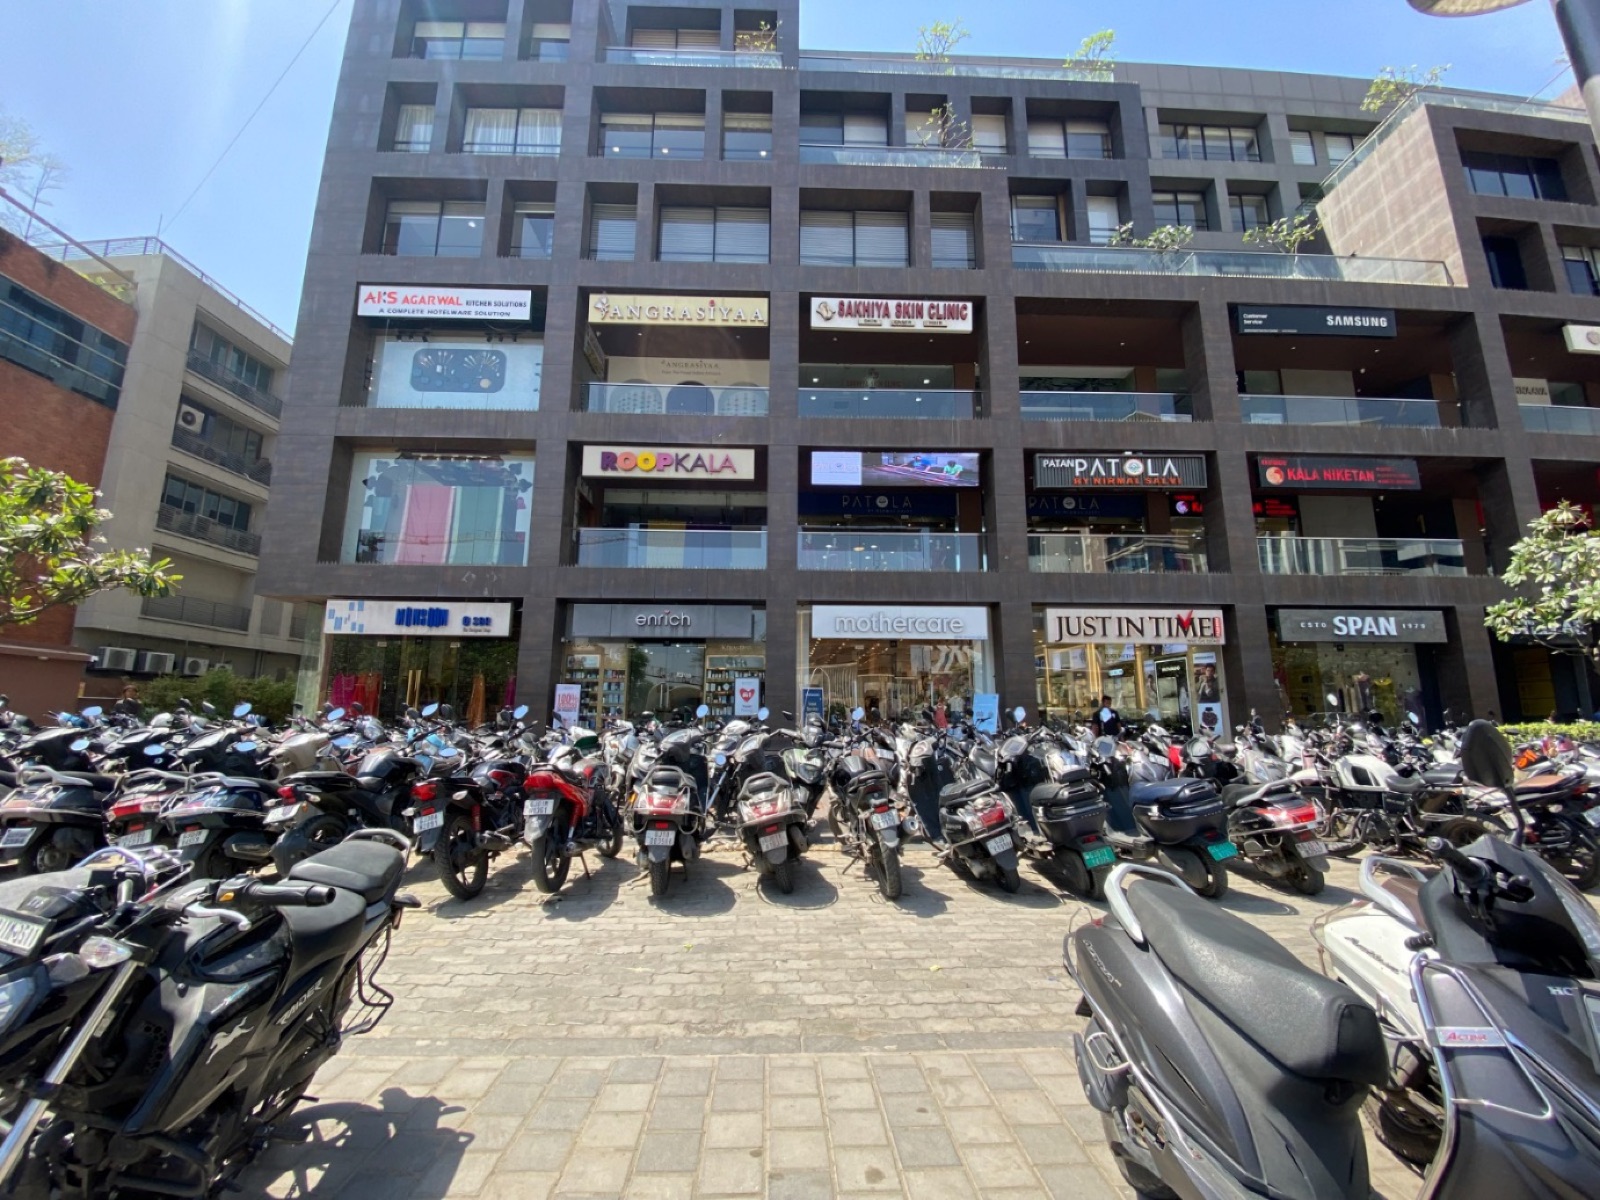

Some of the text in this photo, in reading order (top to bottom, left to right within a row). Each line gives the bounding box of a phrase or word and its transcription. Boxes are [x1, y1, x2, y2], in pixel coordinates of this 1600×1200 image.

[401, 295, 463, 306] AGARWAL
[838, 300, 968, 320] SAKHIYA SKIN CLINIC
[1326, 315, 1388, 328] SAMSUNG
[600, 451, 737, 473] ROOPKALA
[1042, 458, 1178, 477] PATAN PATOLA
[1073, 477, 1182, 486] BY NIRMAL SALVI
[1286, 467, 1320, 481] KALA
[1323, 469, 1375, 482] NIKETAN
[635, 609, 691, 627] enrich
[834, 612, 965, 634] mothercare
[1056, 610, 1214, 642] JUST IN TIME
[1332, 615, 1398, 636] SPAN
